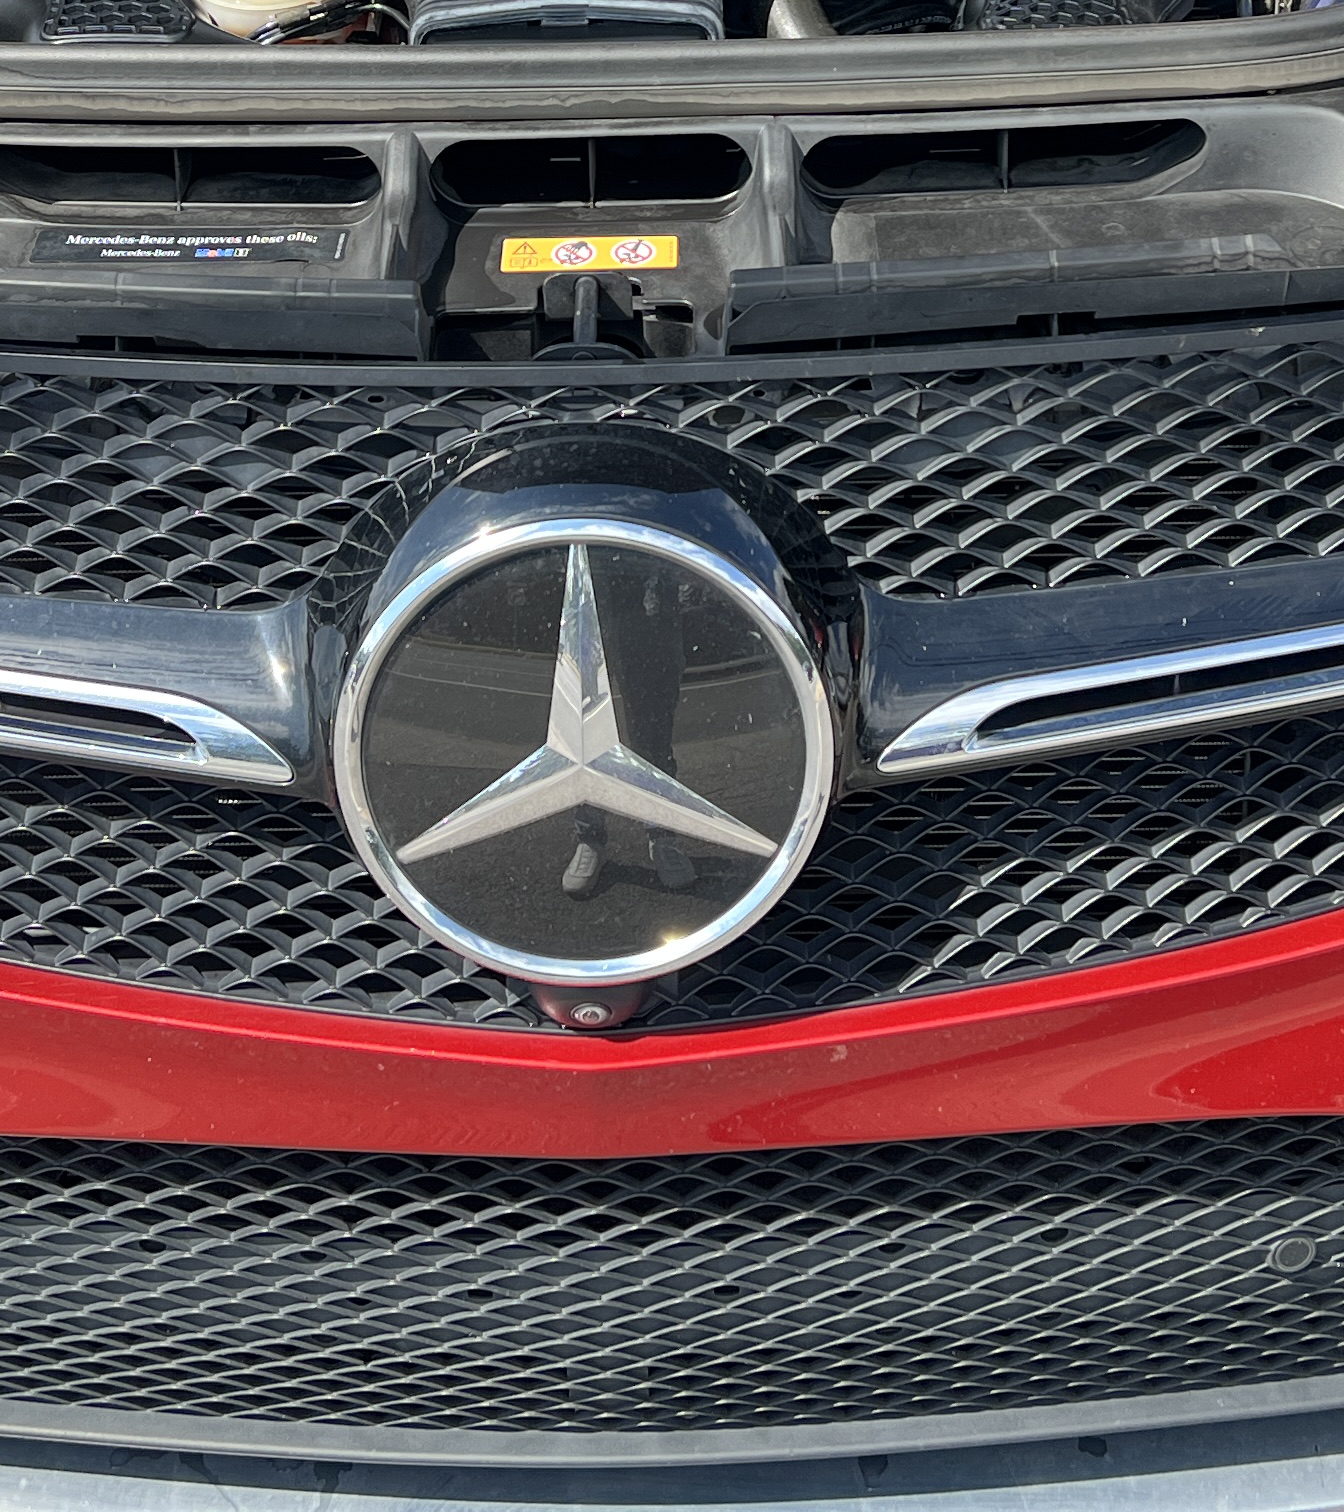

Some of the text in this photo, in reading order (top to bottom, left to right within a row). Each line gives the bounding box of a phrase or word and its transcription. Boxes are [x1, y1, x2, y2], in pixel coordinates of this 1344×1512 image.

[66, 234, 174, 245] Mercedes-Benz
[177, 235, 242, 246] approves
[245, 234, 284, 244] these
[100, 248, 181, 257] Mercedes-Benz
